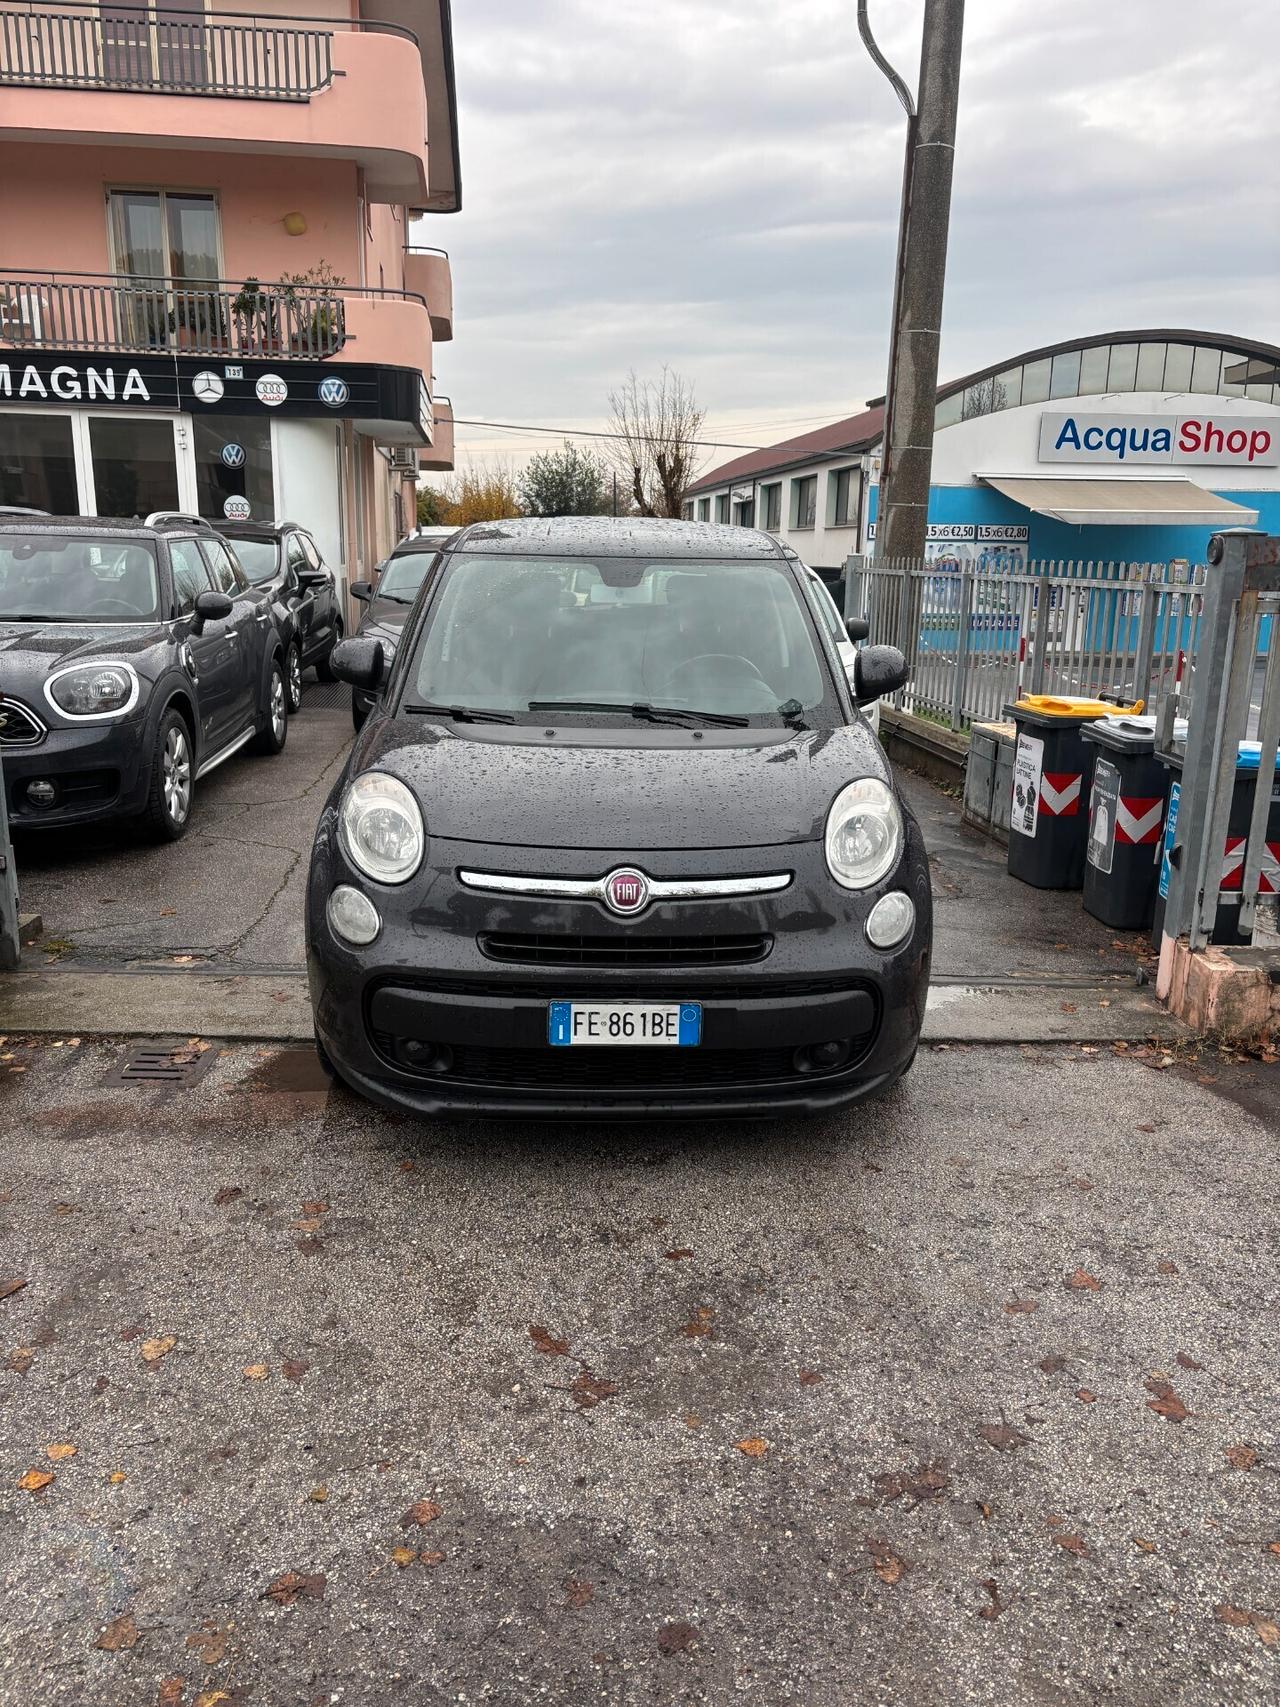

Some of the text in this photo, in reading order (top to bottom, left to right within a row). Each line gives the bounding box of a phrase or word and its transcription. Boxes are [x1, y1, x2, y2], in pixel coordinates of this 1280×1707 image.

[1055, 418, 1271, 462] Acqua Shop
[938, 526, 949, 537] x6
[951, 526, 974, 538] €2,50
[979, 527, 1027, 539] 1,5 x6 €2,80
[616, 883, 638, 899] FIAT
